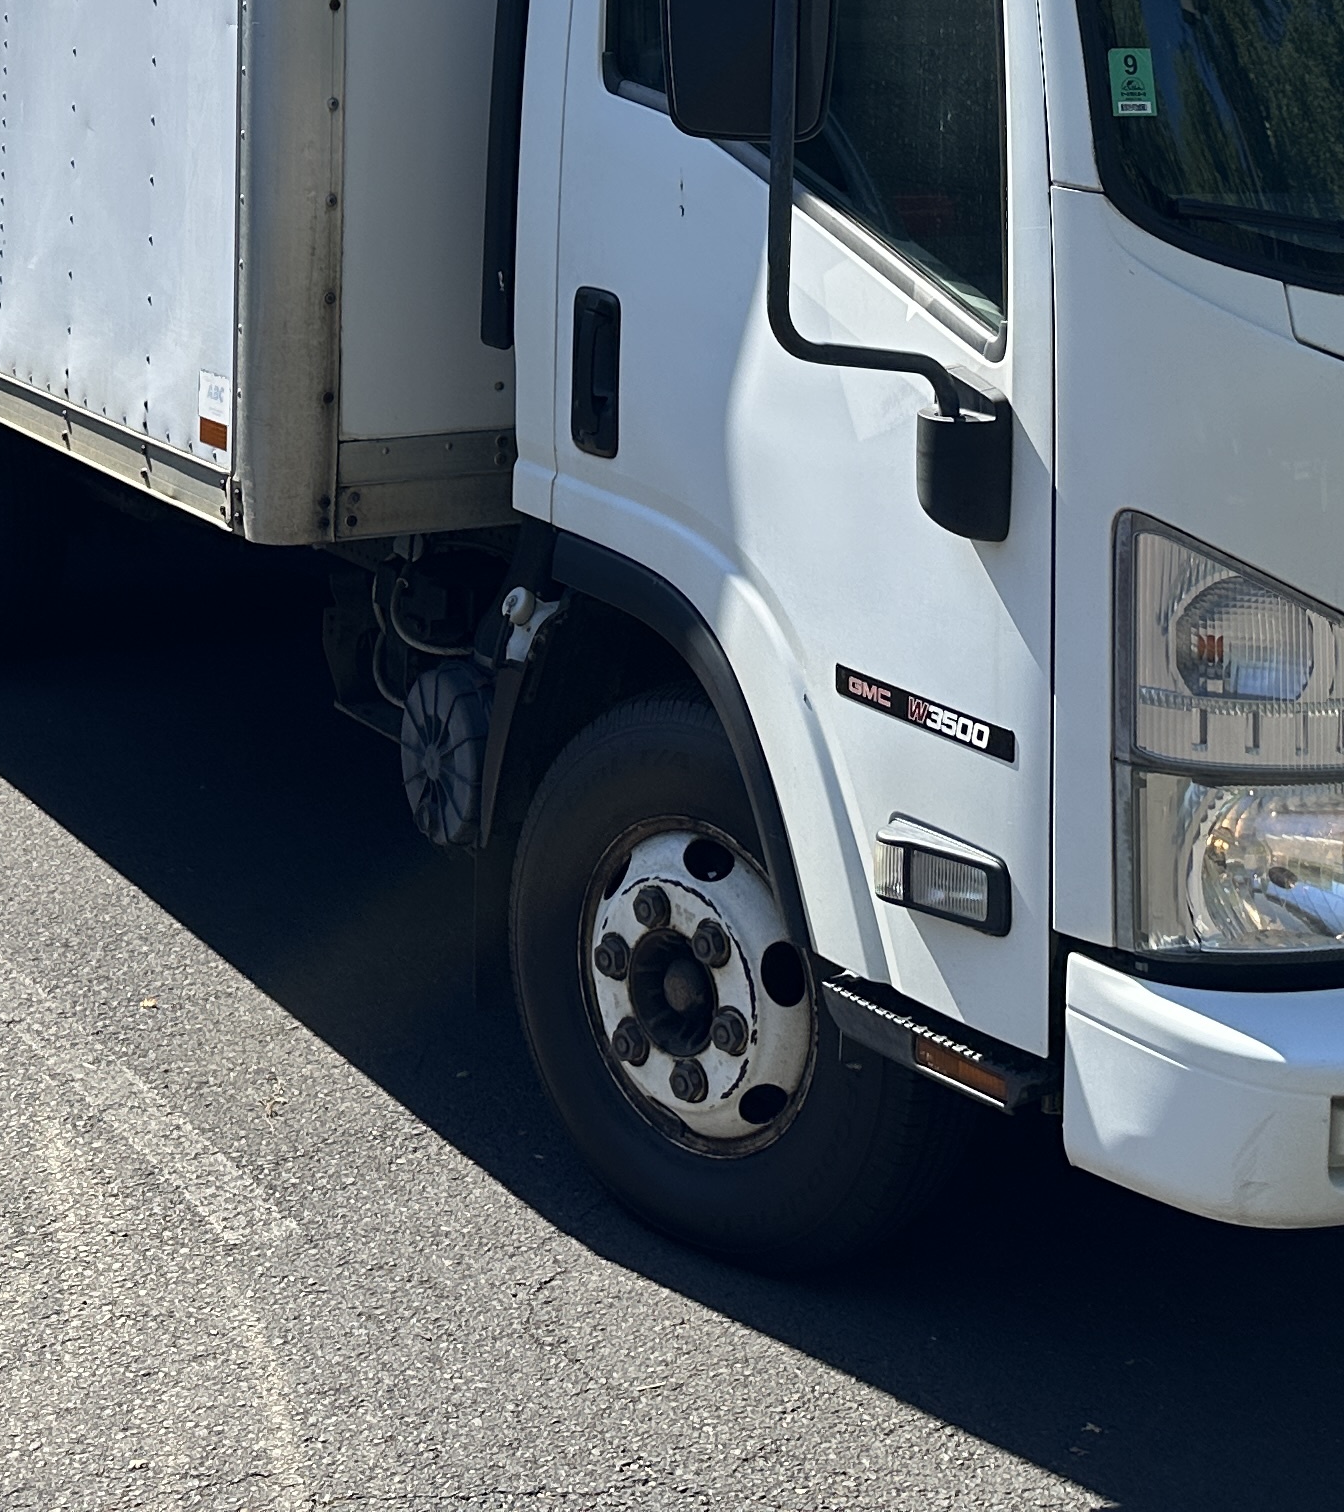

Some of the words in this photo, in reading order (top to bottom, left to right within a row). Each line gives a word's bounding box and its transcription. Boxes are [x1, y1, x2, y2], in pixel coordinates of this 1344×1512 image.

[1123, 54, 1138, 76] 9
[848, 675, 892, 708] GMC
[908, 696, 990, 749] W3500
